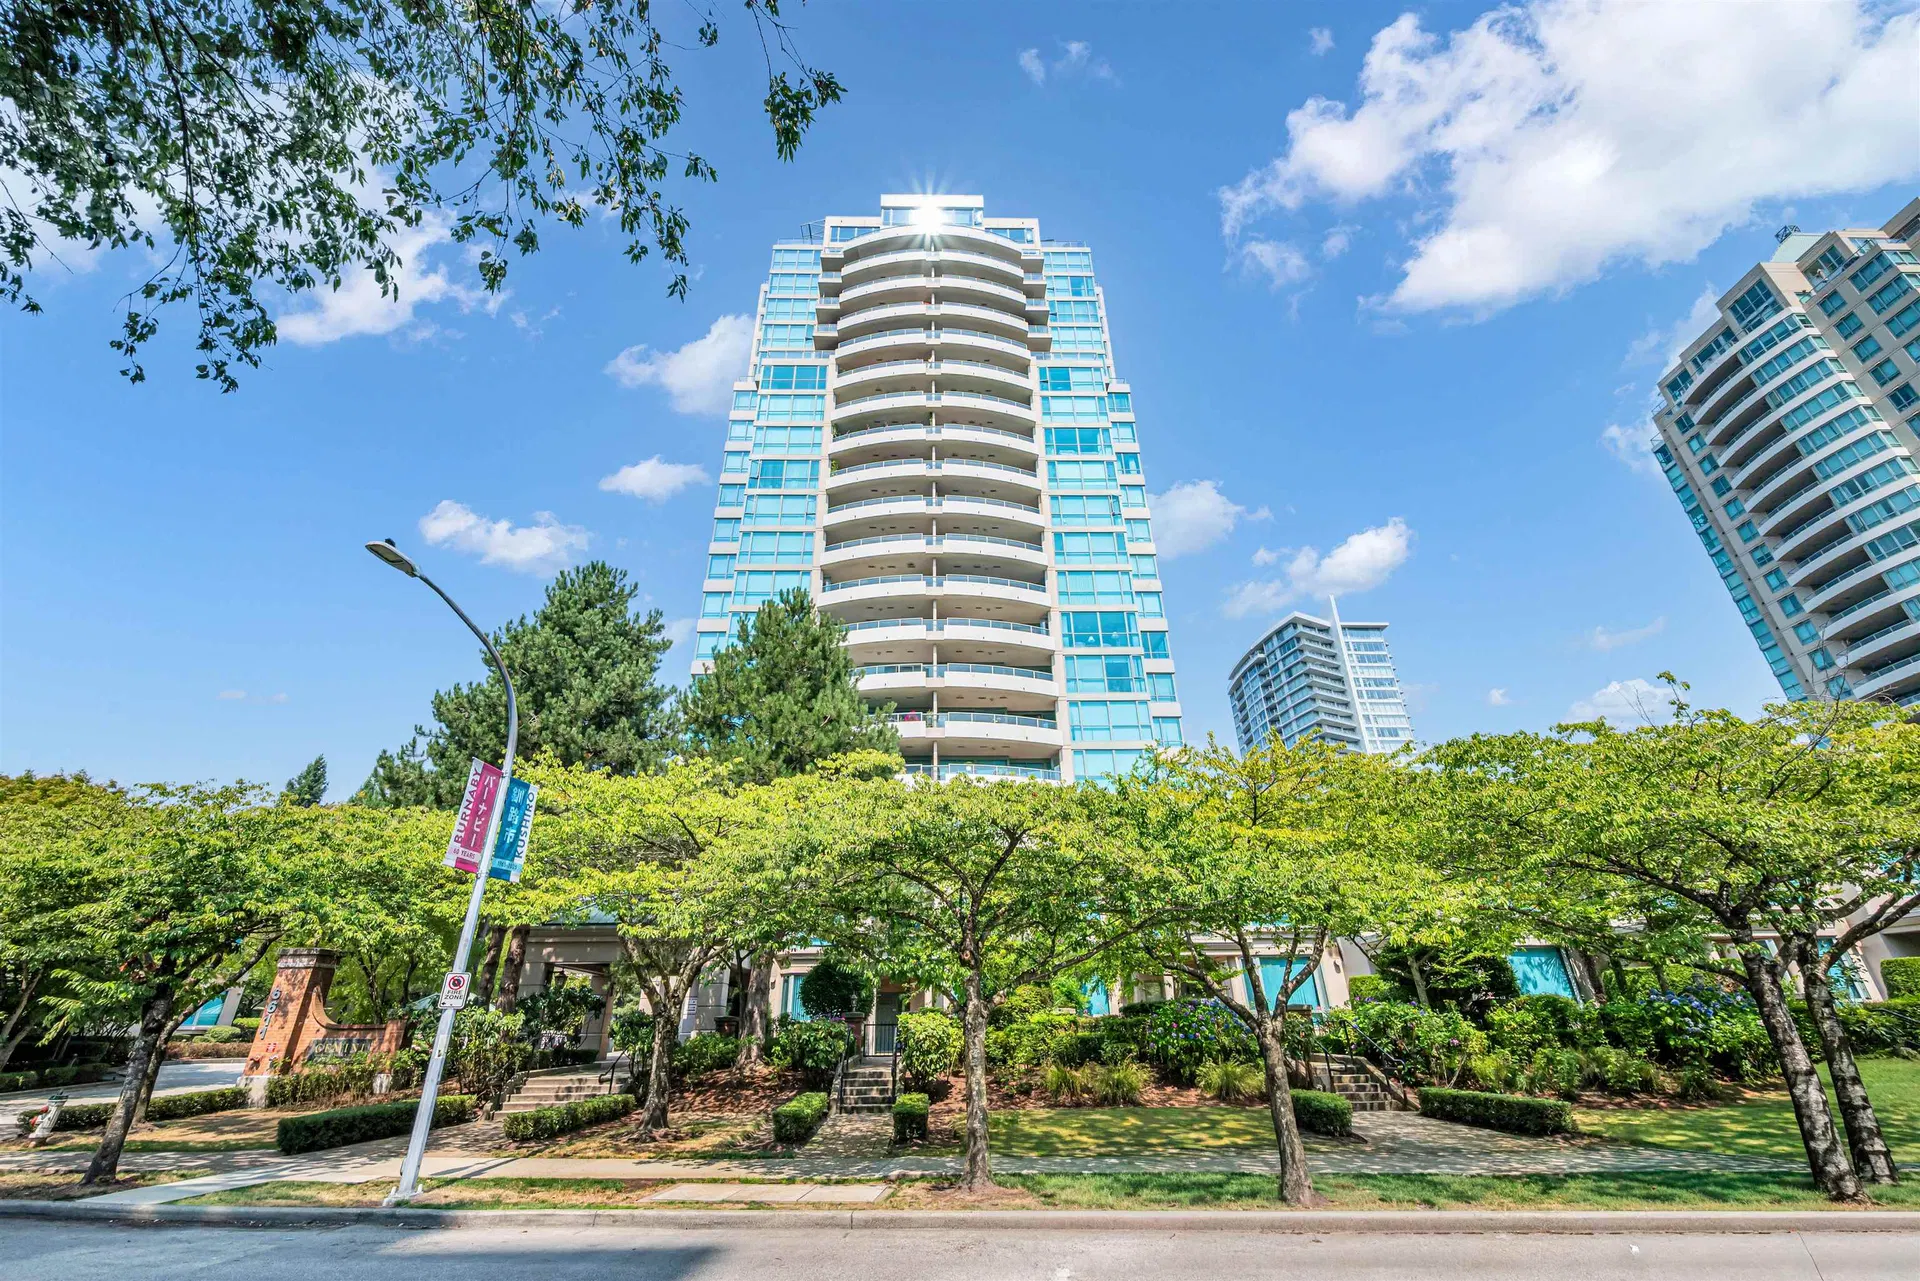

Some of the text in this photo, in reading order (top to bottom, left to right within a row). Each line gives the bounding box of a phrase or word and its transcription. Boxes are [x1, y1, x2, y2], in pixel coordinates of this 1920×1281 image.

[454, 768, 482, 844] BURNABY
[471, 775, 497, 847] バーナビー
[515, 792, 535, 859] KUSHIRO
[461, 850, 475, 859] YEARS
